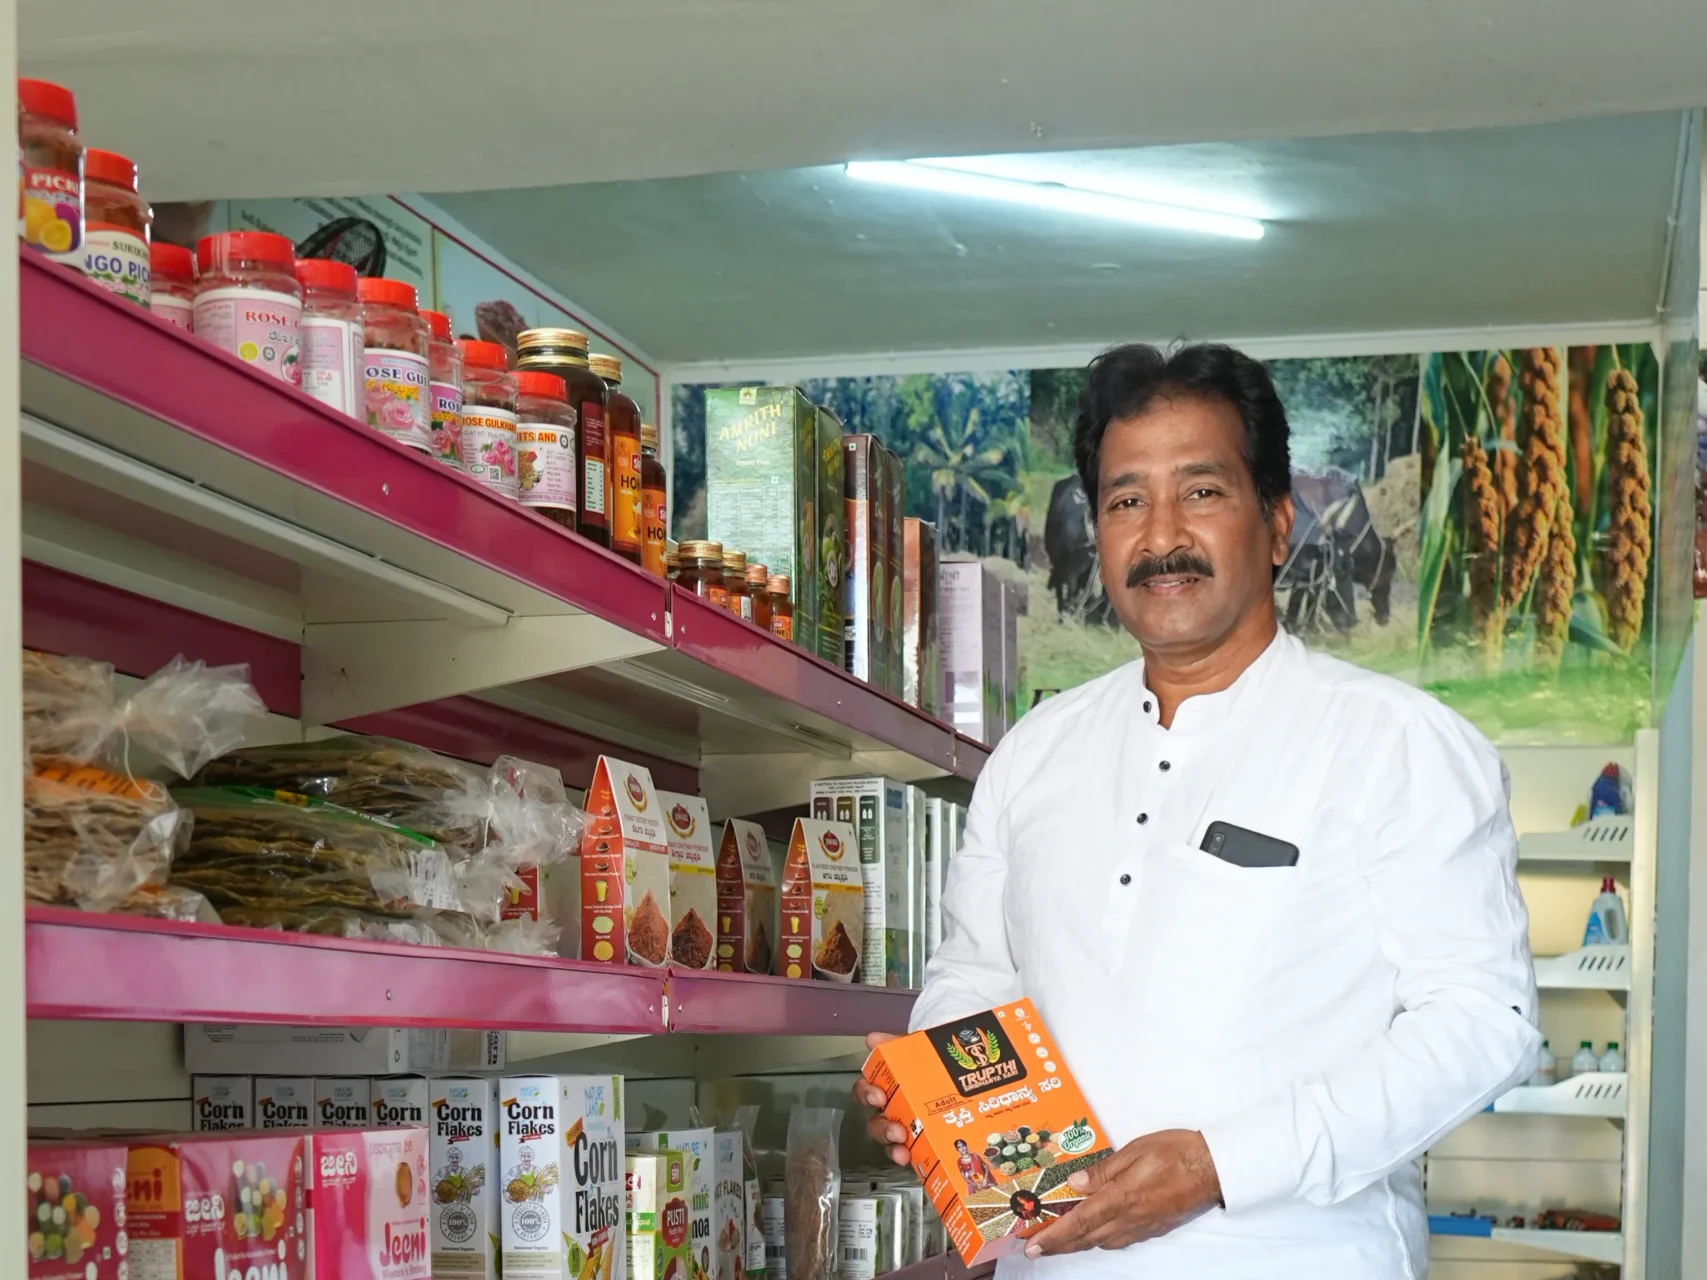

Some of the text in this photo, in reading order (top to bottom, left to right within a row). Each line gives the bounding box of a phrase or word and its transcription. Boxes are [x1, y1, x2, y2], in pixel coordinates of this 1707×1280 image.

[128, 261, 149, 283] PIC
[245, 311, 290, 328] ROSE
[366, 367, 429, 387] OSE GUL
[439, 398, 462, 412] ROS
[719, 403, 783, 441] AMRITH
[538, 433, 556, 443] AND
[736, 421, 777, 454] NONI
[958, 1060, 1018, 1088] TRUPTHI
[934, 1096, 957, 1109] Adult
[978, 1085, 1038, 1113] ಸಿರಿಧಾನ್ಯ
[1038, 1077, 1062, 1093] ಸರಿ
[200, 1101, 245, 1119] Corn
[263, 1101, 308, 1119] Corn
[321, 1101, 367, 1119] Corn
[376, 1102, 421, 1121] Corn
[437, 1103, 482, 1121] Corn
[507, 1102, 554, 1120] Corn
[437, 1122, 483, 1137] Flakes
[508, 1121, 555, 1135] Flakes
[1062, 1123, 1086, 1142] 100%
[1061, 1131, 1093, 1153] Organic
[574, 1131, 618, 1186] Corn
[575, 1187, 619, 1234] Flakes
[667, 1208, 684, 1227] PUSTI
[379, 1217, 426, 1267] Jeeni
